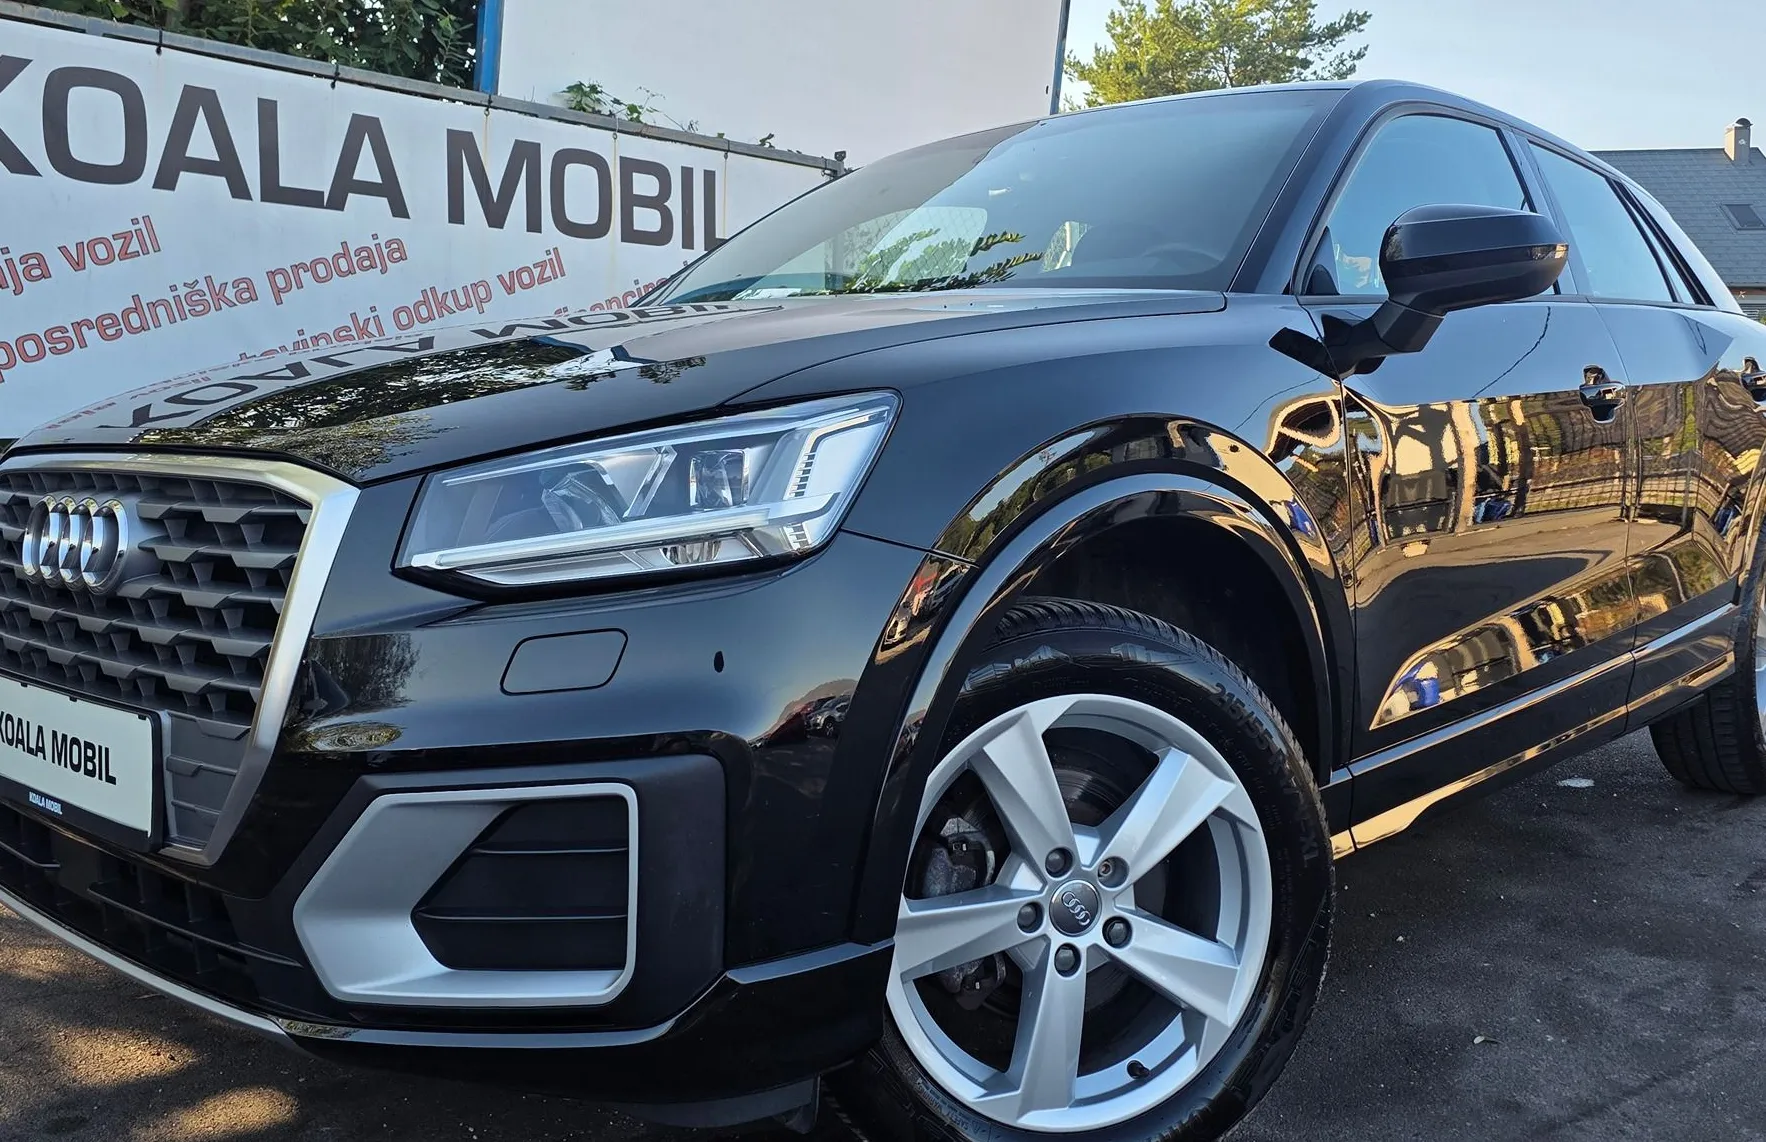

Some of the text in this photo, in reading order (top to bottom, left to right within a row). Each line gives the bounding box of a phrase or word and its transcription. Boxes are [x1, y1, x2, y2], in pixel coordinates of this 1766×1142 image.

[446, 128, 729, 252] MOBIL
[0, 215, 161, 296] ja vozil
[266, 234, 408, 305] prodaja
[393, 279, 492, 331] odkup
[497, 247, 566, 296] vozil
[51, 730, 117, 786] MOBIL
[29, 791, 63, 815] KOALA MOBIL
